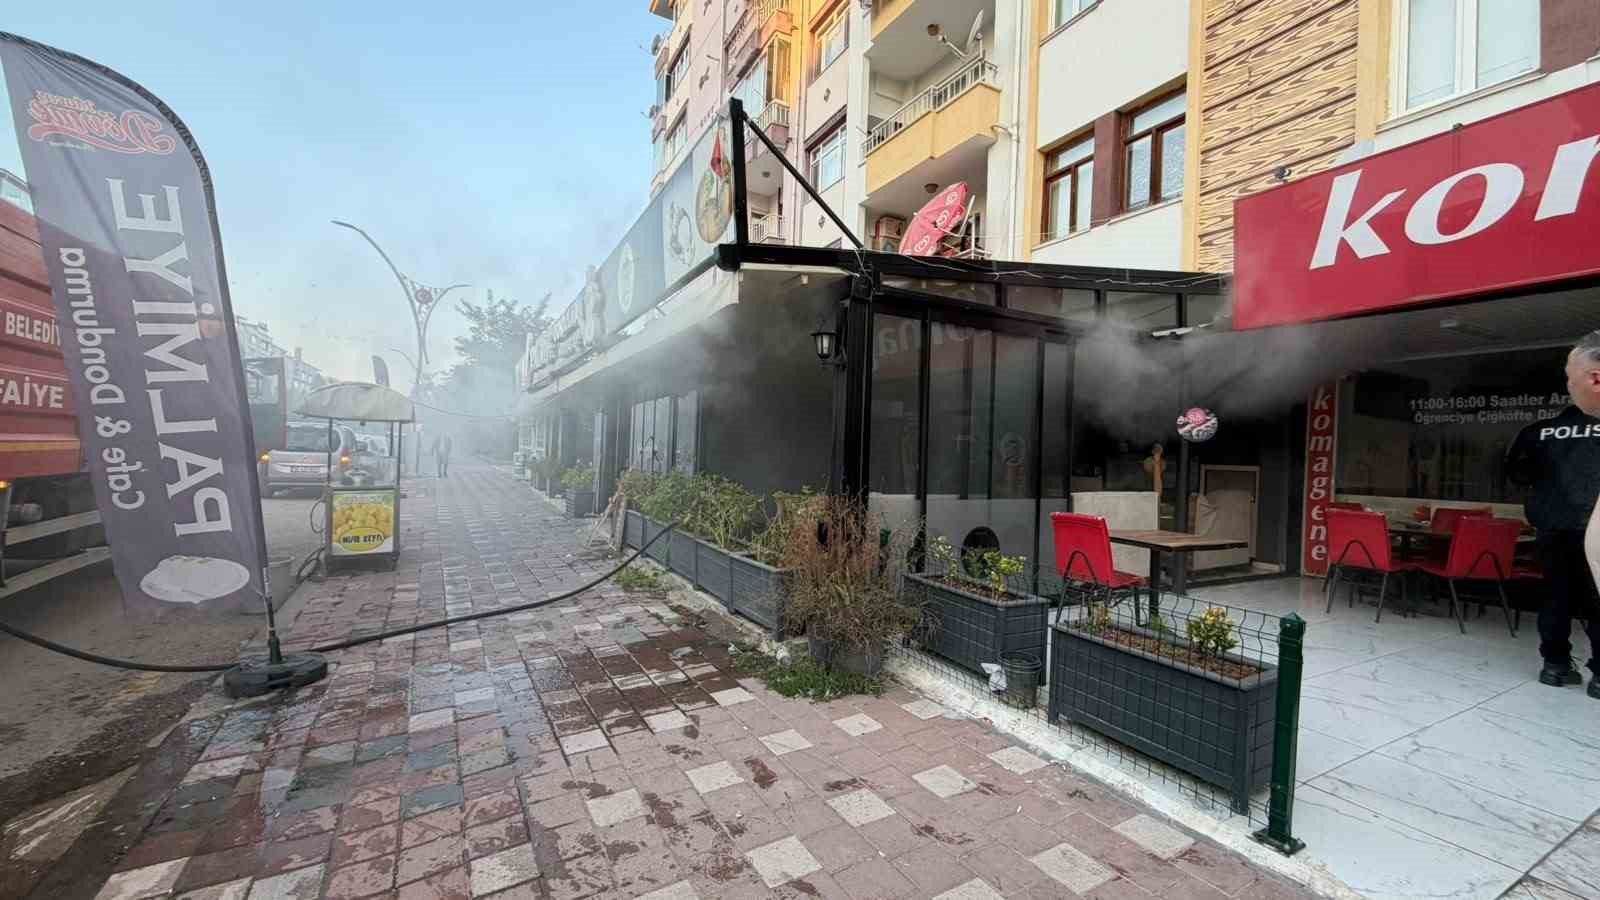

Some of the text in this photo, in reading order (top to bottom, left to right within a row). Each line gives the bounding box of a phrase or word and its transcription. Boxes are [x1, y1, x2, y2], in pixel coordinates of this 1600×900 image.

[0, 376, 64, 409] AİYE
[1408, 394, 1486, 410] 11:00-16:00
[1489, 393, 1545, 407] Saatler
[1308, 386, 1334, 561] komagene
